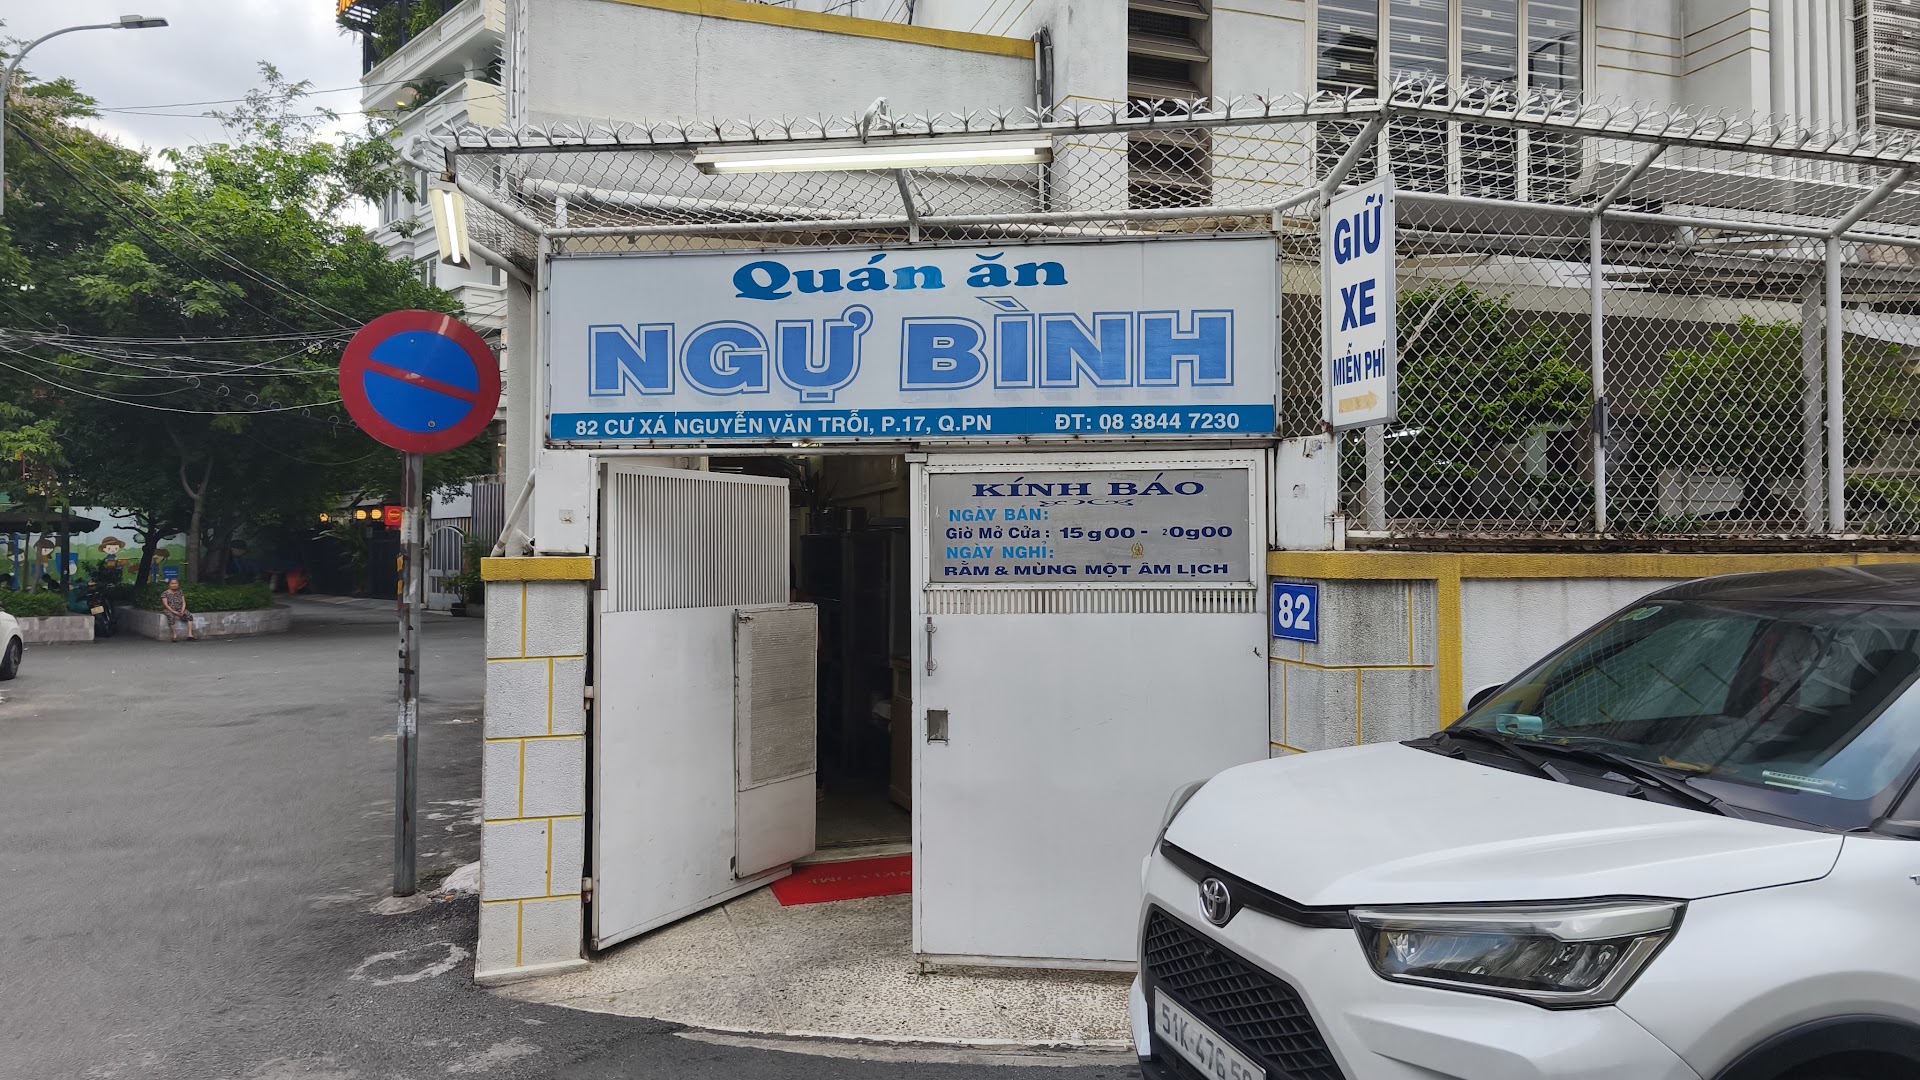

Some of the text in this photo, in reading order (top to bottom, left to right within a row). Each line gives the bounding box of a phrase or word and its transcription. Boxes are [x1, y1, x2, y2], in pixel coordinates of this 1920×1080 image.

[1334, 193, 1383, 265] GIỮ
[733, 252, 1068, 300] Quán ăn
[1341, 279, 1375, 332] XE
[589, 296, 1234, 403] NGỰ BÌNH
[1334, 340, 1385, 386] MIỄN PHÍ
[575, 409, 991, 436] 82 CƯ XÁ NGUYỄN VĂN TRỖI, P.17, Q.PN
[1055, 413, 1240, 430] ĐT: 08 3844 7230
[972, 472, 1204, 497] KÍNH BÁO
[949, 504, 1049, 522] NGÀY BÁN:
[945, 526, 973, 539] Giờ
[979, 525, 1003, 539] Mở
[946, 541, 1054, 559] NGÀY NGHỈ:
[994, 565, 1009, 575] &
[1014, 562, 1077, 576] MÙNG
[1085, 563, 1131, 577] MỘT
[1138, 562, 1171, 575] ÂM
[1177, 564, 1228, 577] LỊCH
[1278, 593, 1310, 630] 82
